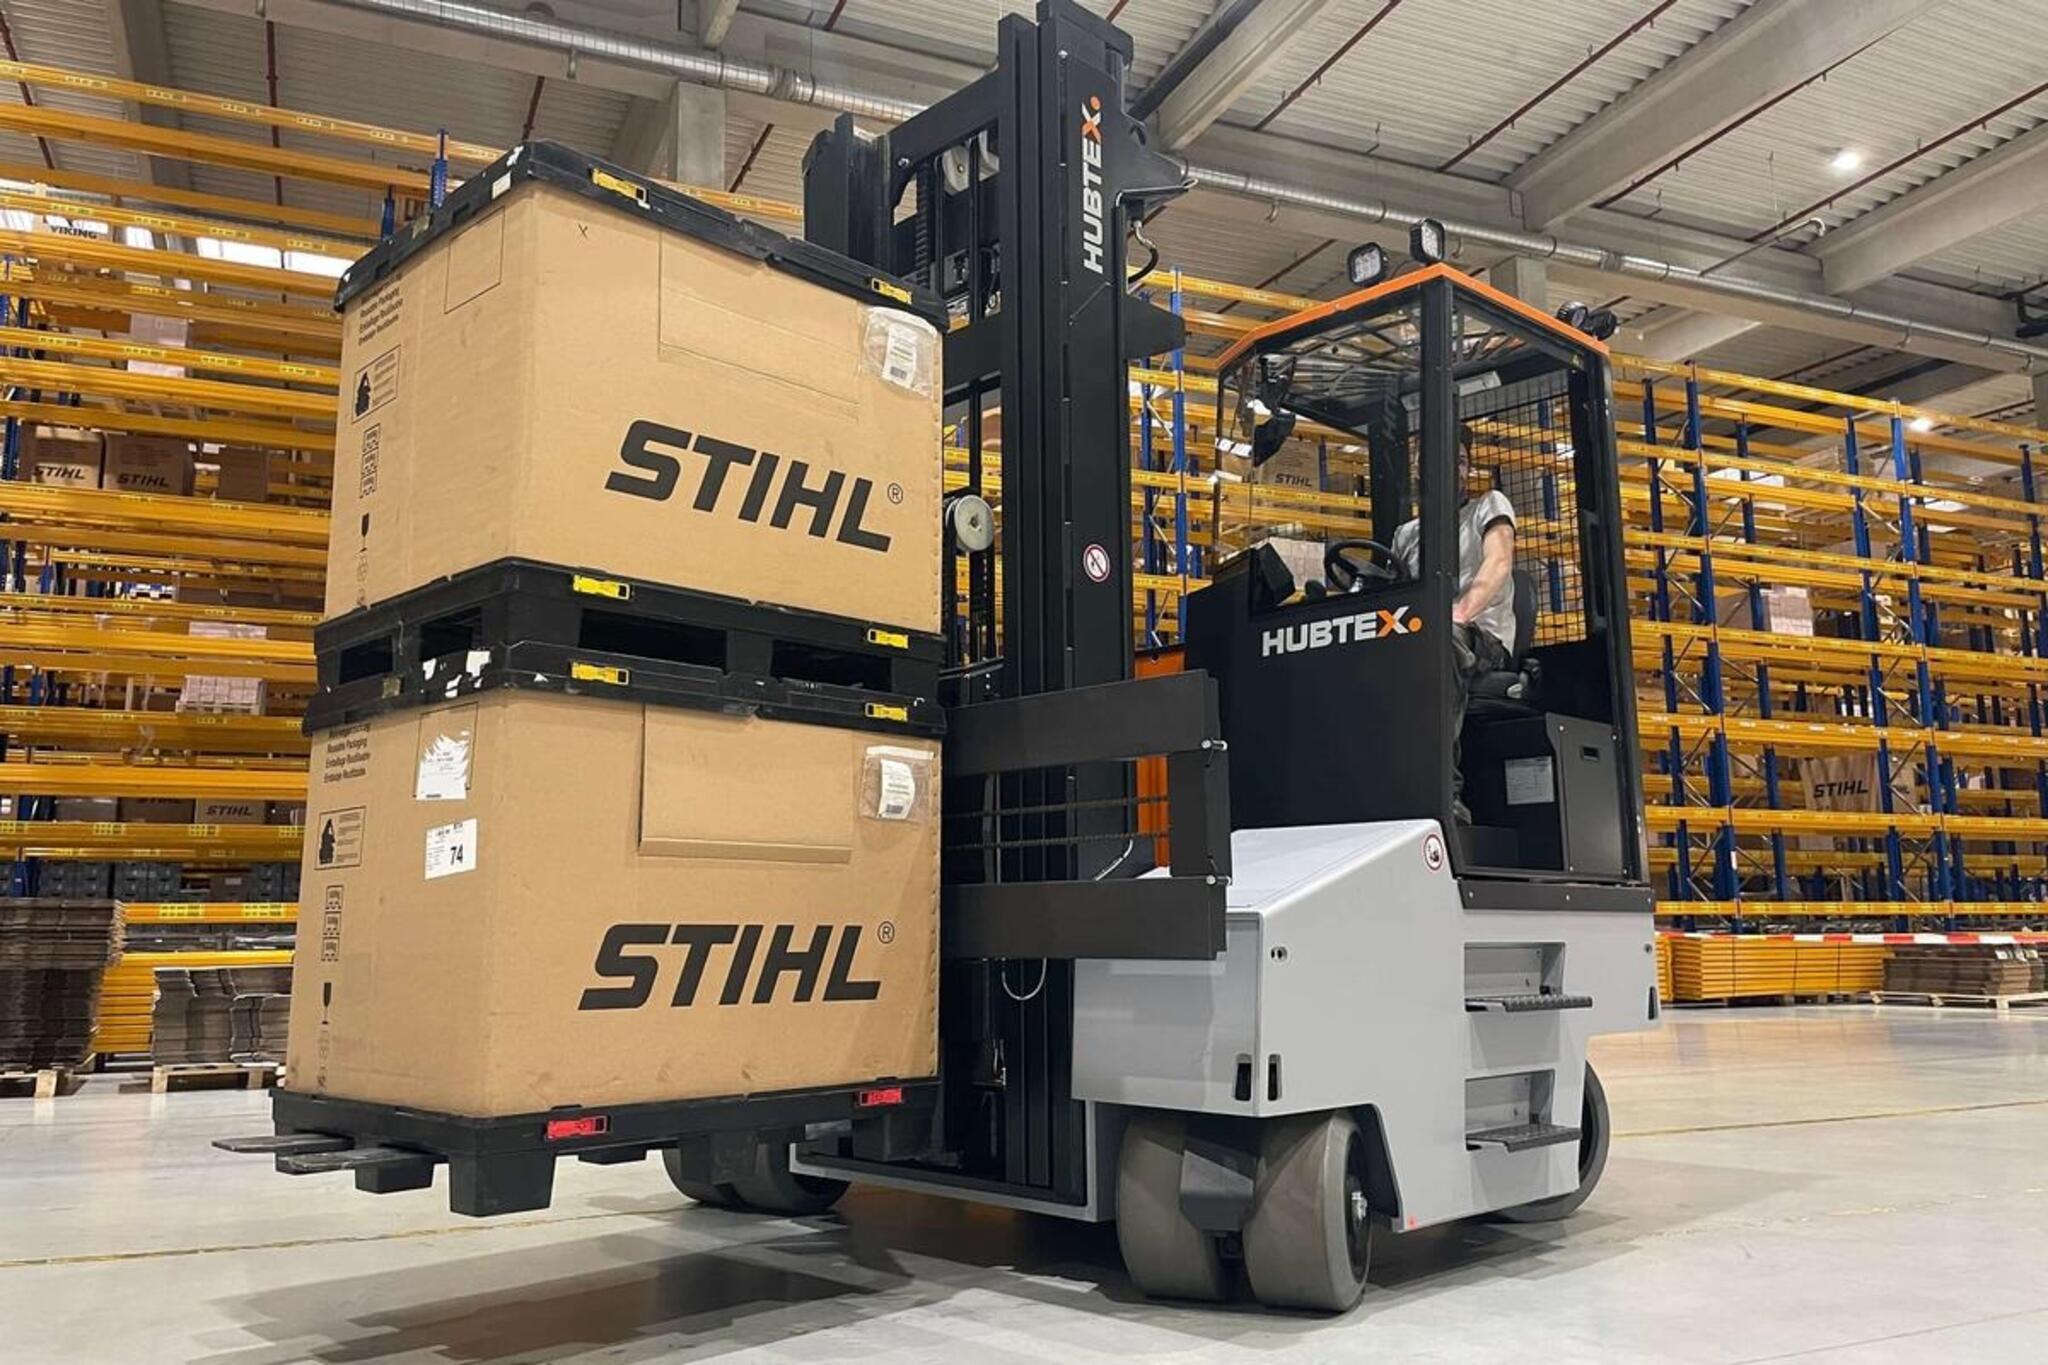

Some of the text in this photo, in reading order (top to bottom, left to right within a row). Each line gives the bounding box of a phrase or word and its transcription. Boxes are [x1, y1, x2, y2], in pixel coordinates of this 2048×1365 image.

[49, 225, 97, 239] VIKING
[33, 465, 86, 480] STIHL
[117, 473, 170, 487] STIHL
[1275, 473, 1312, 487] STIHL
[1813, 780, 1869, 799] STIHL
[205, 805, 253, 817] STIHL
[450, 844, 464, 866] 74
